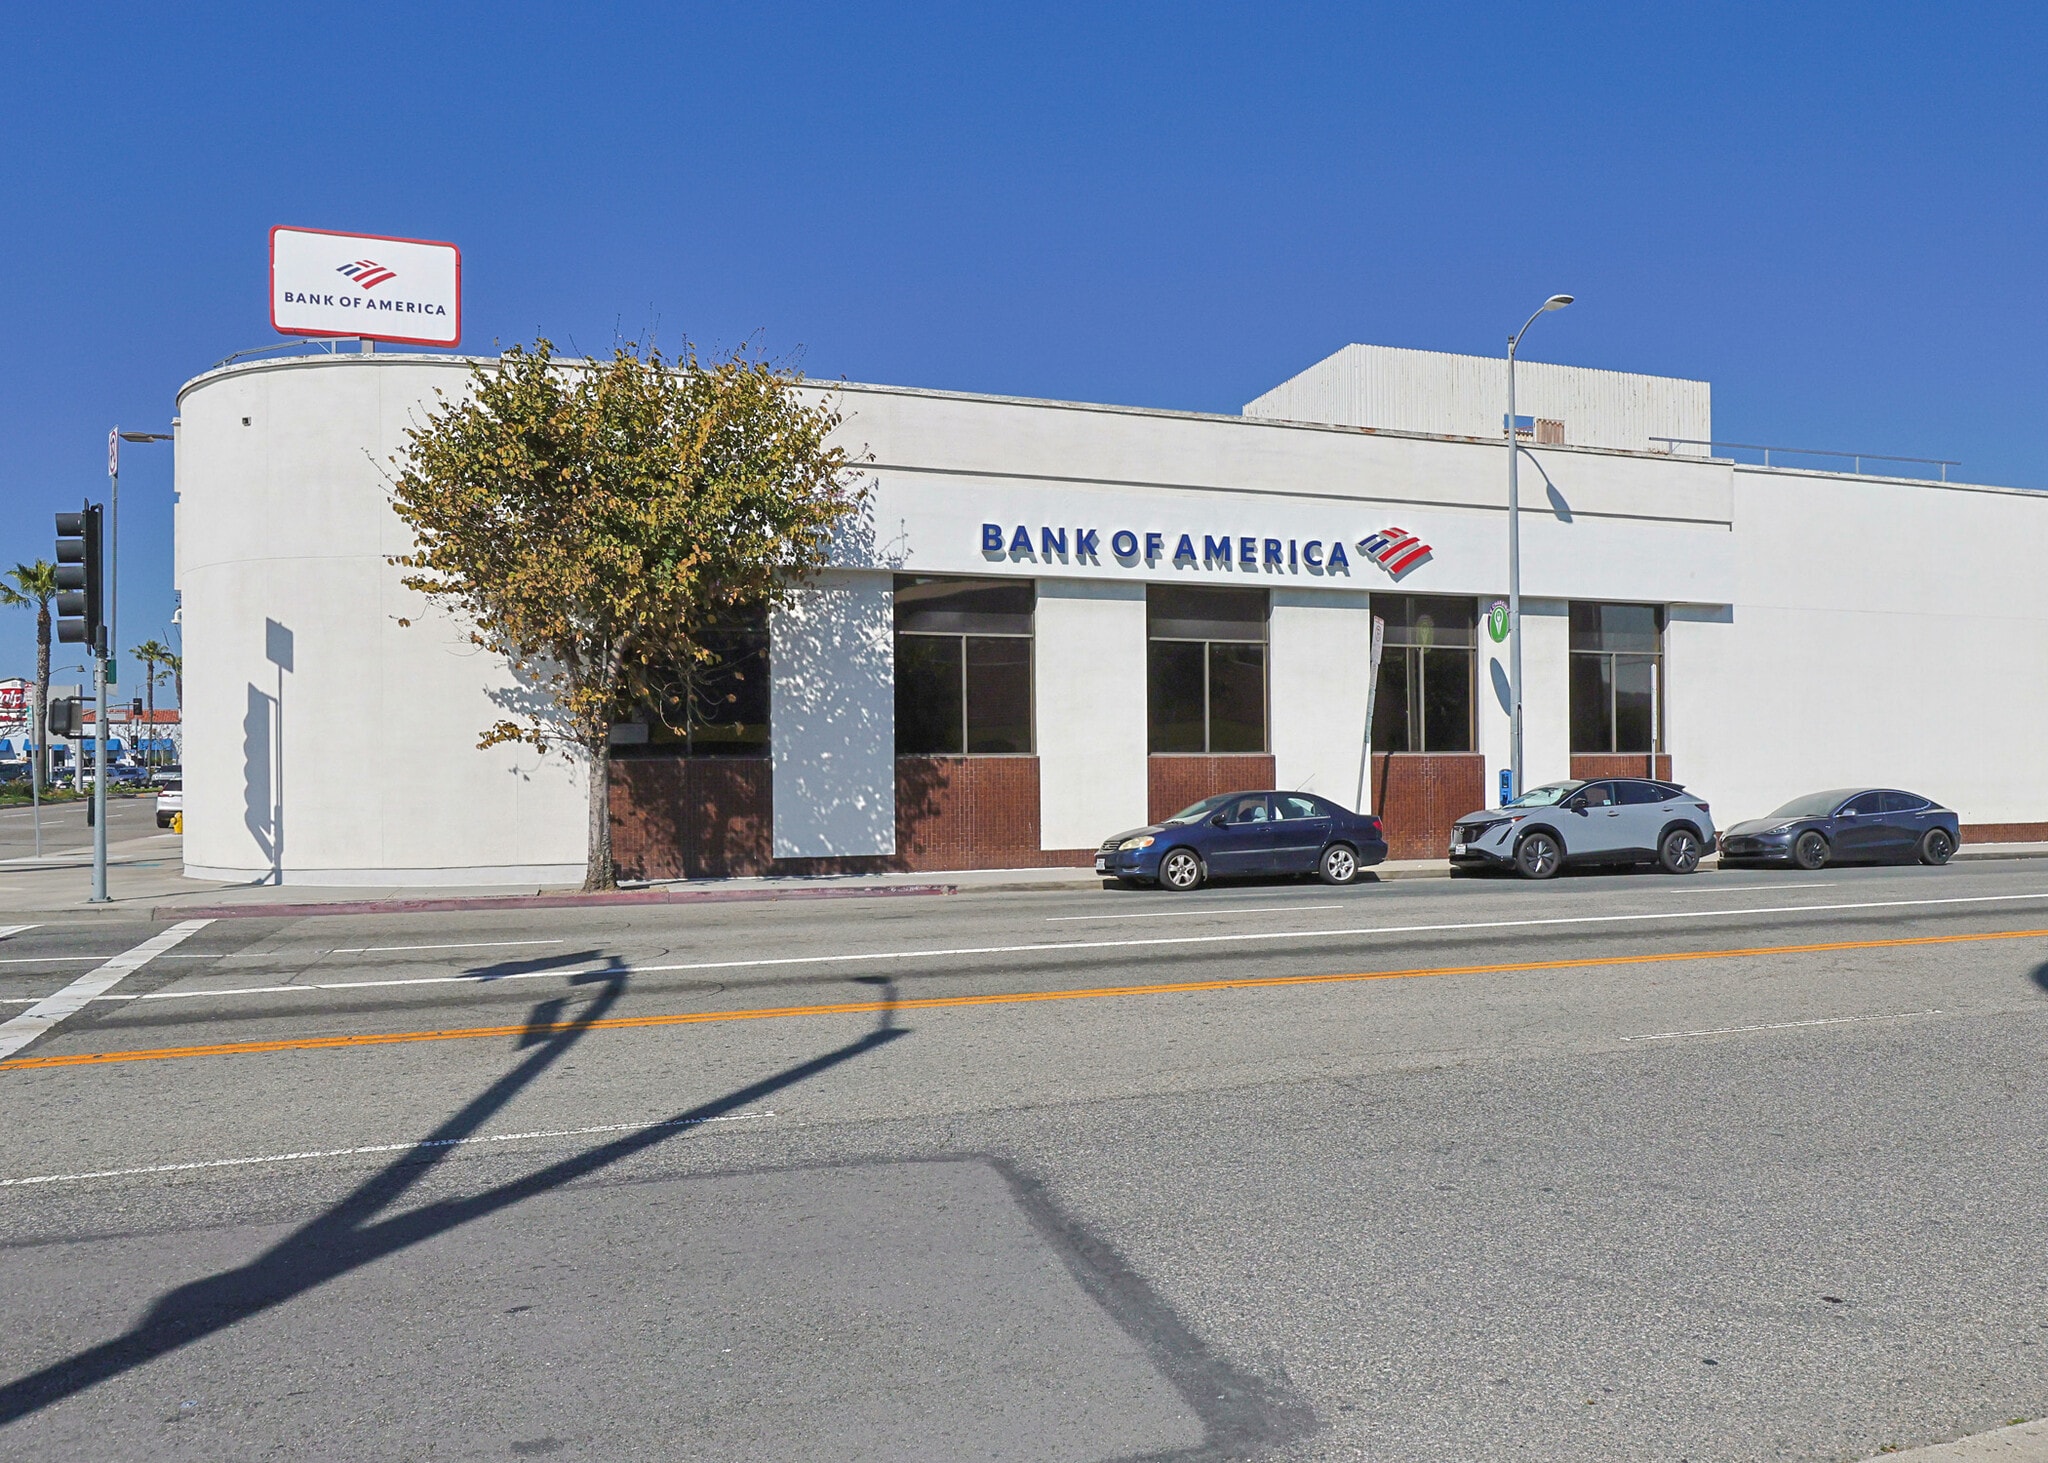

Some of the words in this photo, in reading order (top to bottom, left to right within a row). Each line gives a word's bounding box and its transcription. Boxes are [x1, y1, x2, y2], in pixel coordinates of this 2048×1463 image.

[284, 291, 334, 306] BANK
[339, 296, 362, 309] OF
[366, 298, 446, 316] AMERICA
[982, 523, 1098, 556] BANK
[1111, 530, 1163, 559] OF
[1174, 533, 1350, 568] AMERICA
